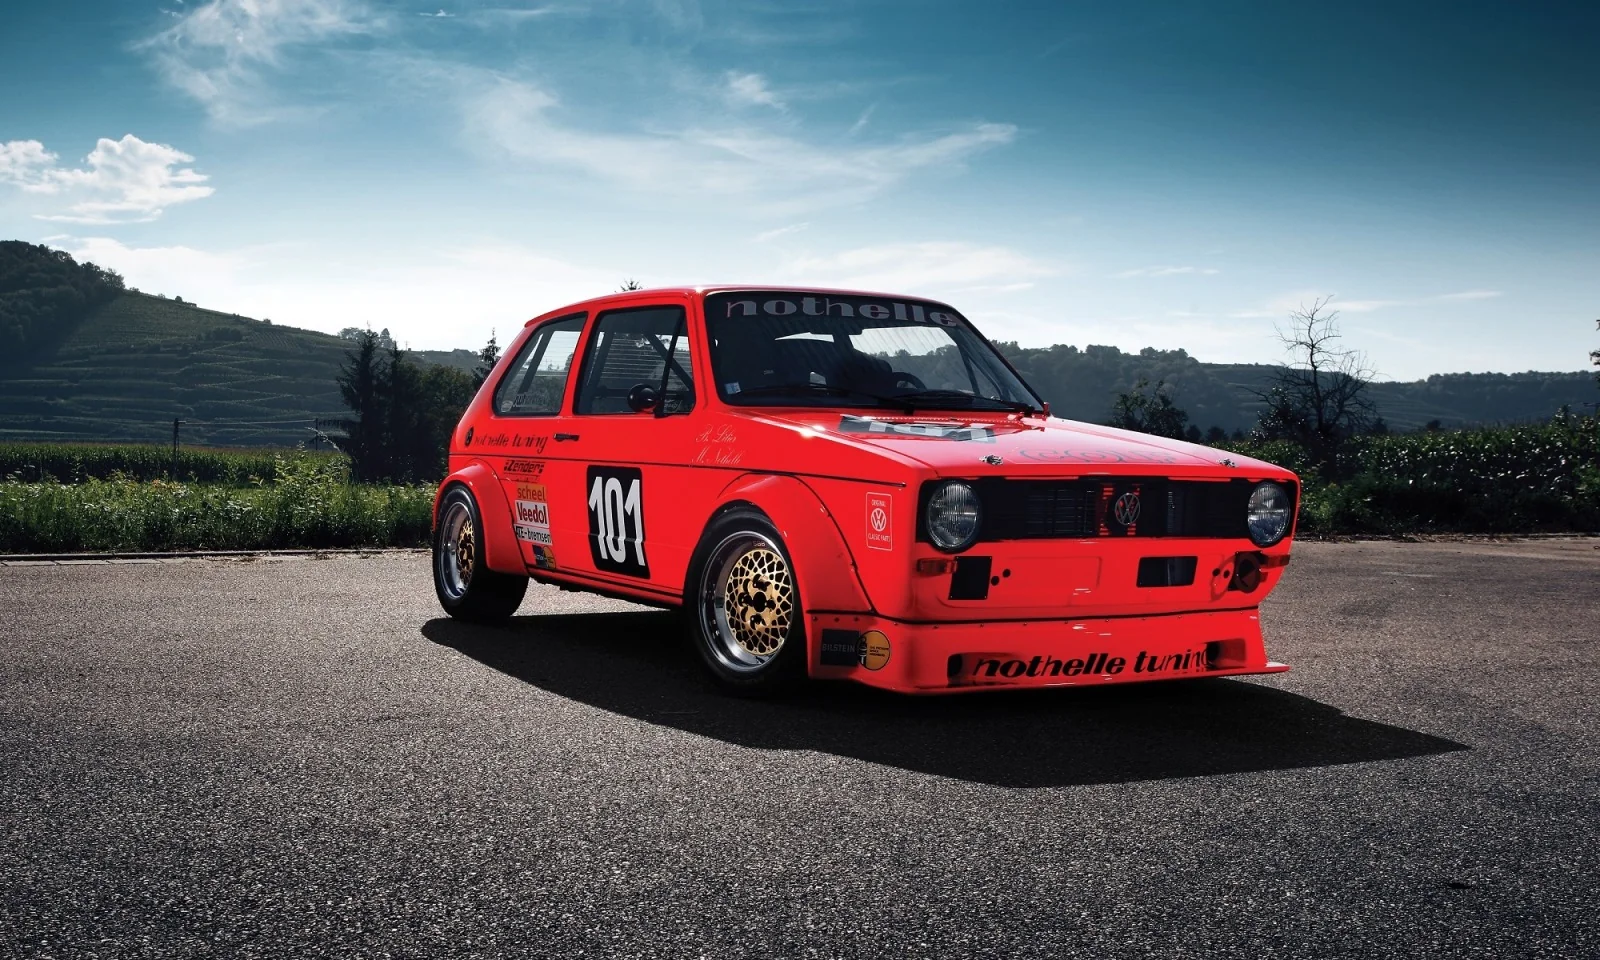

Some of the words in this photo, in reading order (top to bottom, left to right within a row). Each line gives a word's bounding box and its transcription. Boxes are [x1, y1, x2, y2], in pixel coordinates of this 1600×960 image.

[727, 296, 957, 327] nothelle
[517, 485, 547, 502] scheel
[516, 502, 548, 525] Veedol
[588, 476, 646, 567] 101
[822, 643, 856, 653] BILSTEIN
[972, 652, 1127, 679] nothelle
